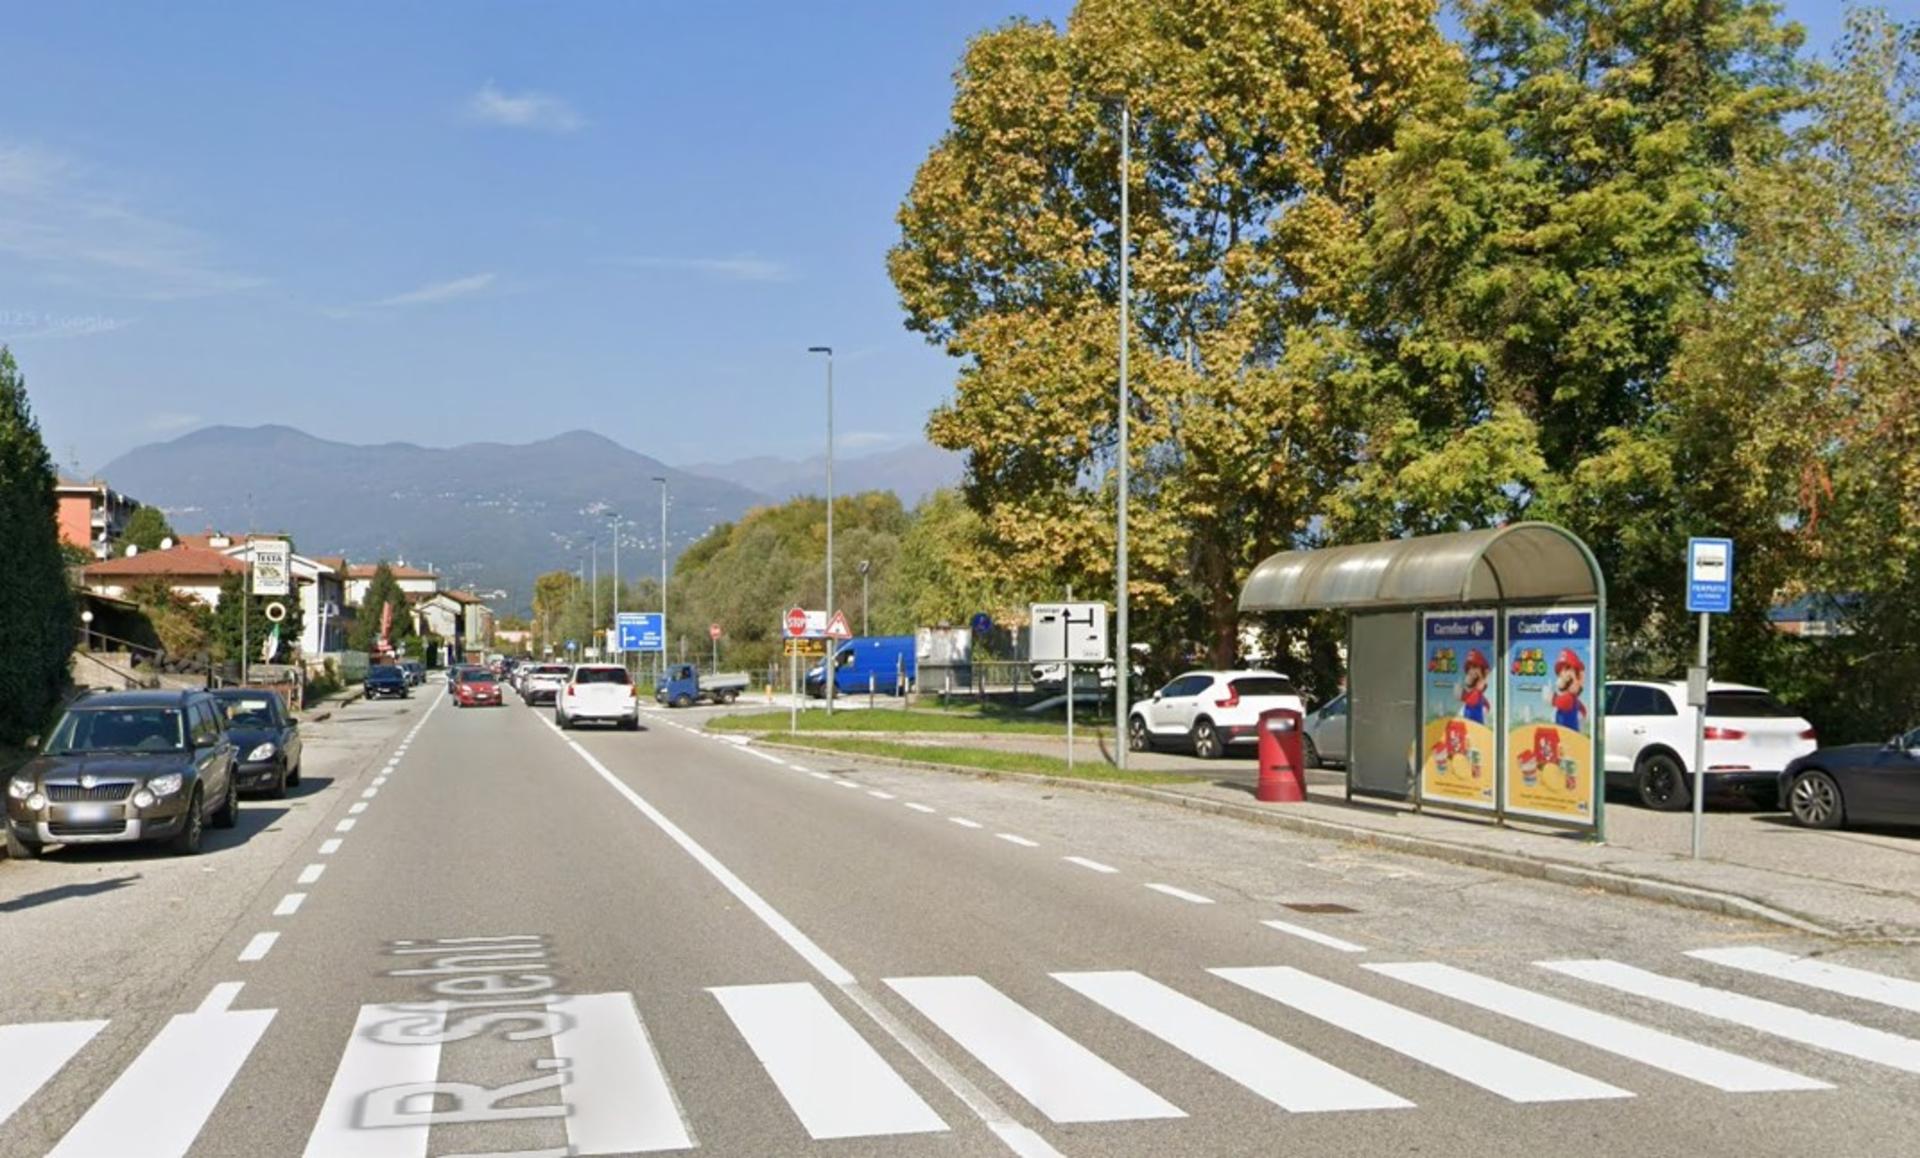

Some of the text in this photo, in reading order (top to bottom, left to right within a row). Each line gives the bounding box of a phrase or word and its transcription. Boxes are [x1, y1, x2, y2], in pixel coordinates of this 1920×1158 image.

[788, 618, 806, 628] STOP
[1434, 621, 1469, 635] Carrefour
[1518, 619, 1560, 633] Carrefour
[1511, 658, 1548, 676] MARIO
